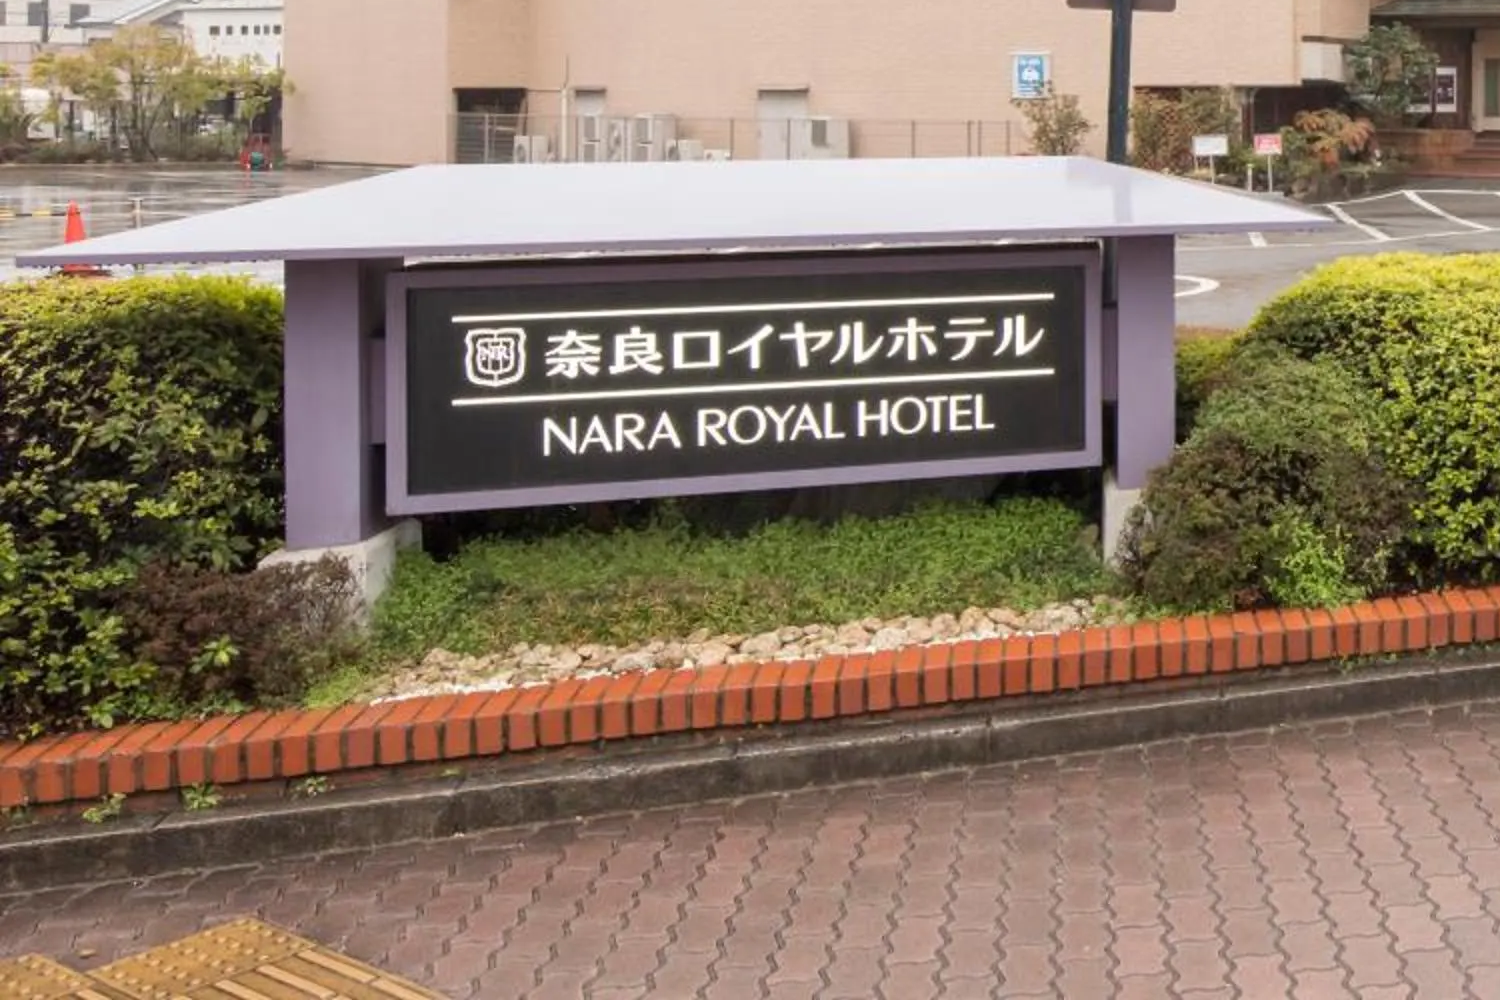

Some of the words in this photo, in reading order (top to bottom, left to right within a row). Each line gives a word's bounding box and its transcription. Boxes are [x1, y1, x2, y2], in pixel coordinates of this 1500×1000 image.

[544, 314, 1044, 380] 奈良ロイヤルホテル
[543, 411, 682, 457] NARA
[697, 402, 845, 446] ROYAL
[857, 393, 995, 438] HOTEL
